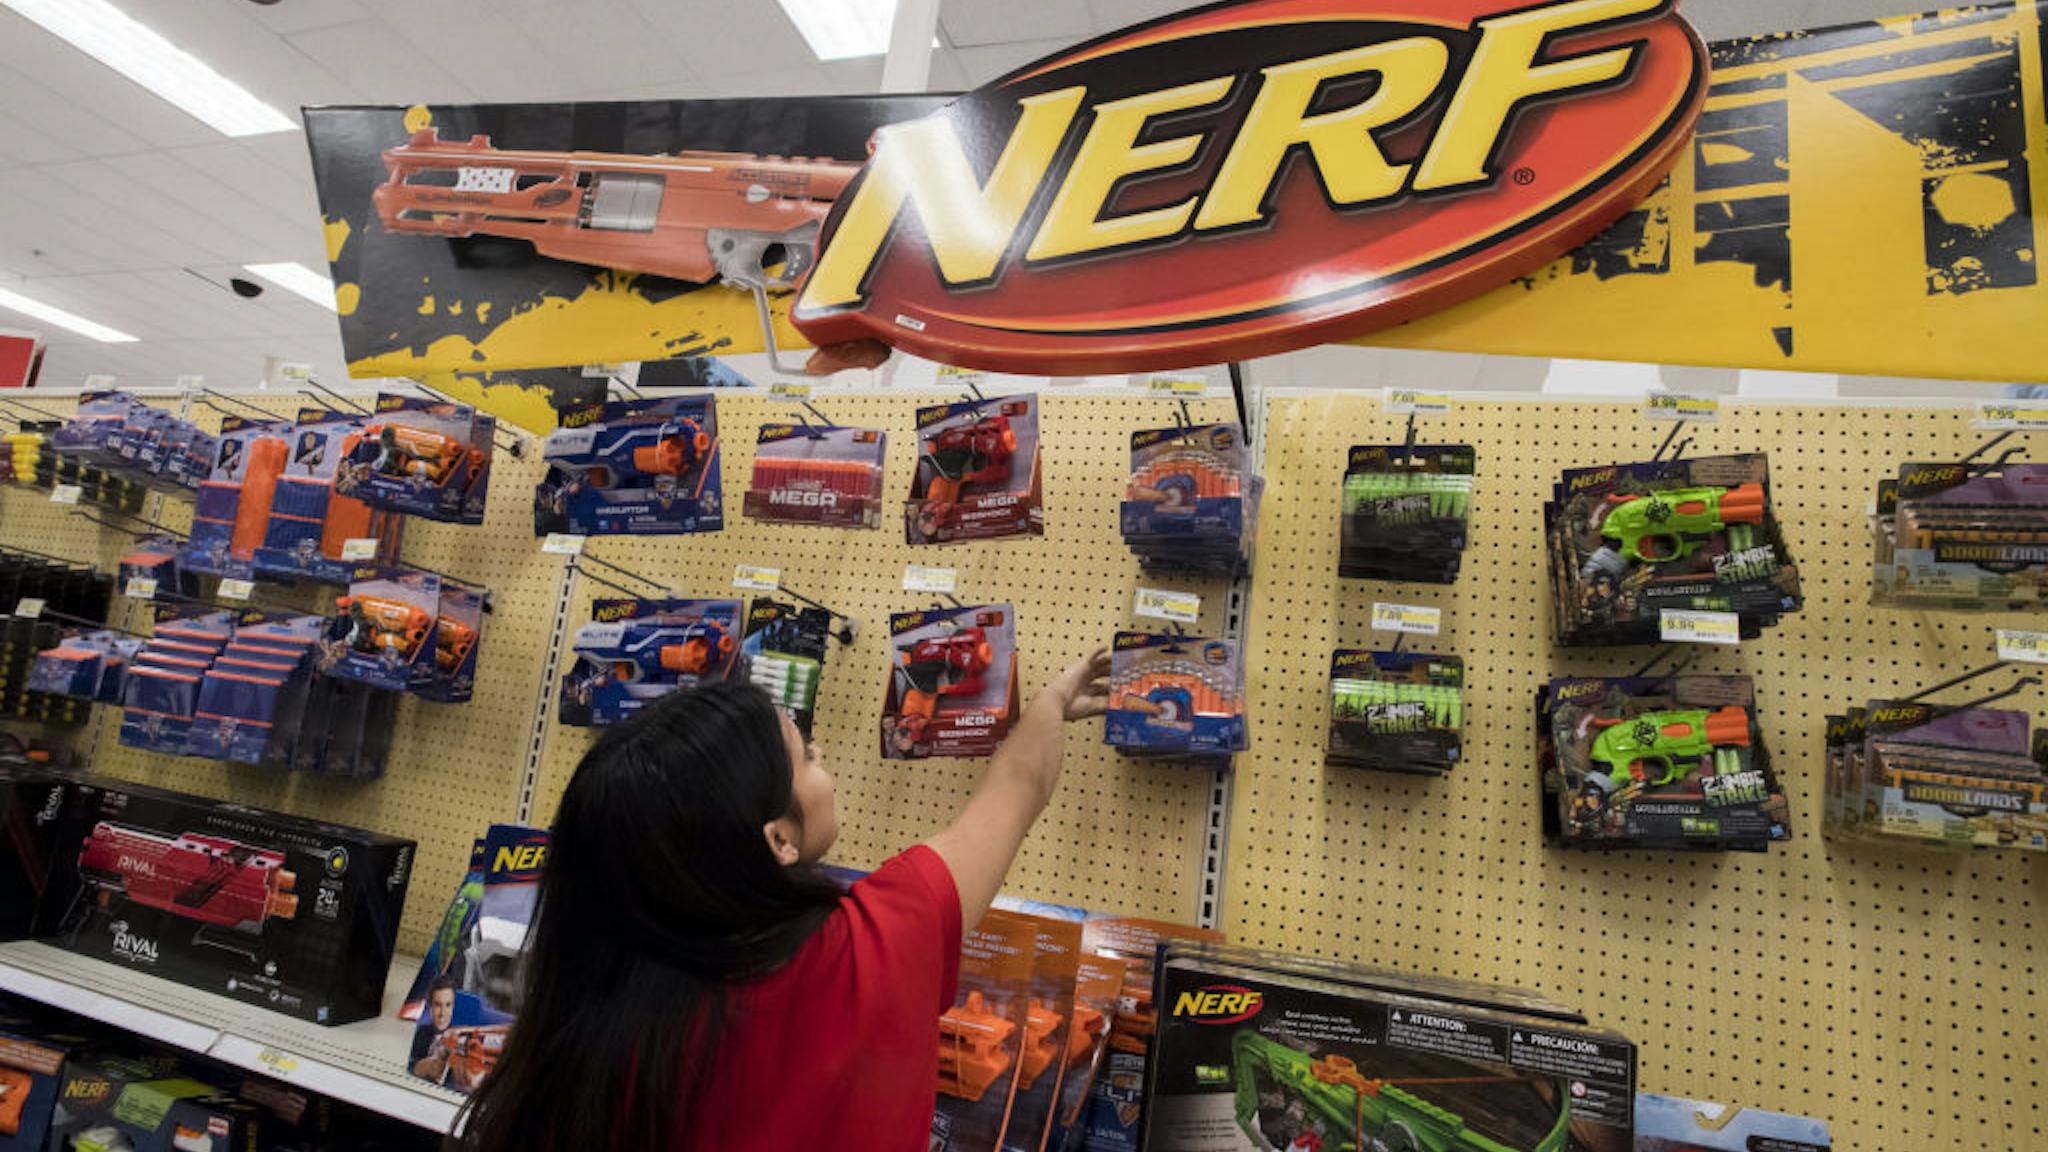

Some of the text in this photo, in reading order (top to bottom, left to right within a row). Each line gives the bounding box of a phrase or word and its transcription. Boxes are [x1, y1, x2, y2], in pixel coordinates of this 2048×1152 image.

[796, 0, 1676, 312] NERF
[1570, 470, 1617, 491] NERF
[1904, 467, 1962, 486] NERF
[769, 489, 838, 507] MEGA
[1557, 682, 1601, 700] NERF
[1871, 707, 1921, 722] NERF
[117, 856, 156, 876] RIVAL
[493, 845, 546, 872] NER
[113, 932, 160, 958] RIVAL
[1173, 992, 1263, 1016] NERF
[1409, 1013, 1467, 1032] ATTENTION:
[1531, 1034, 1600, 1055] PRECAUCIÓN:
[64, 1078, 110, 1099] NERF
